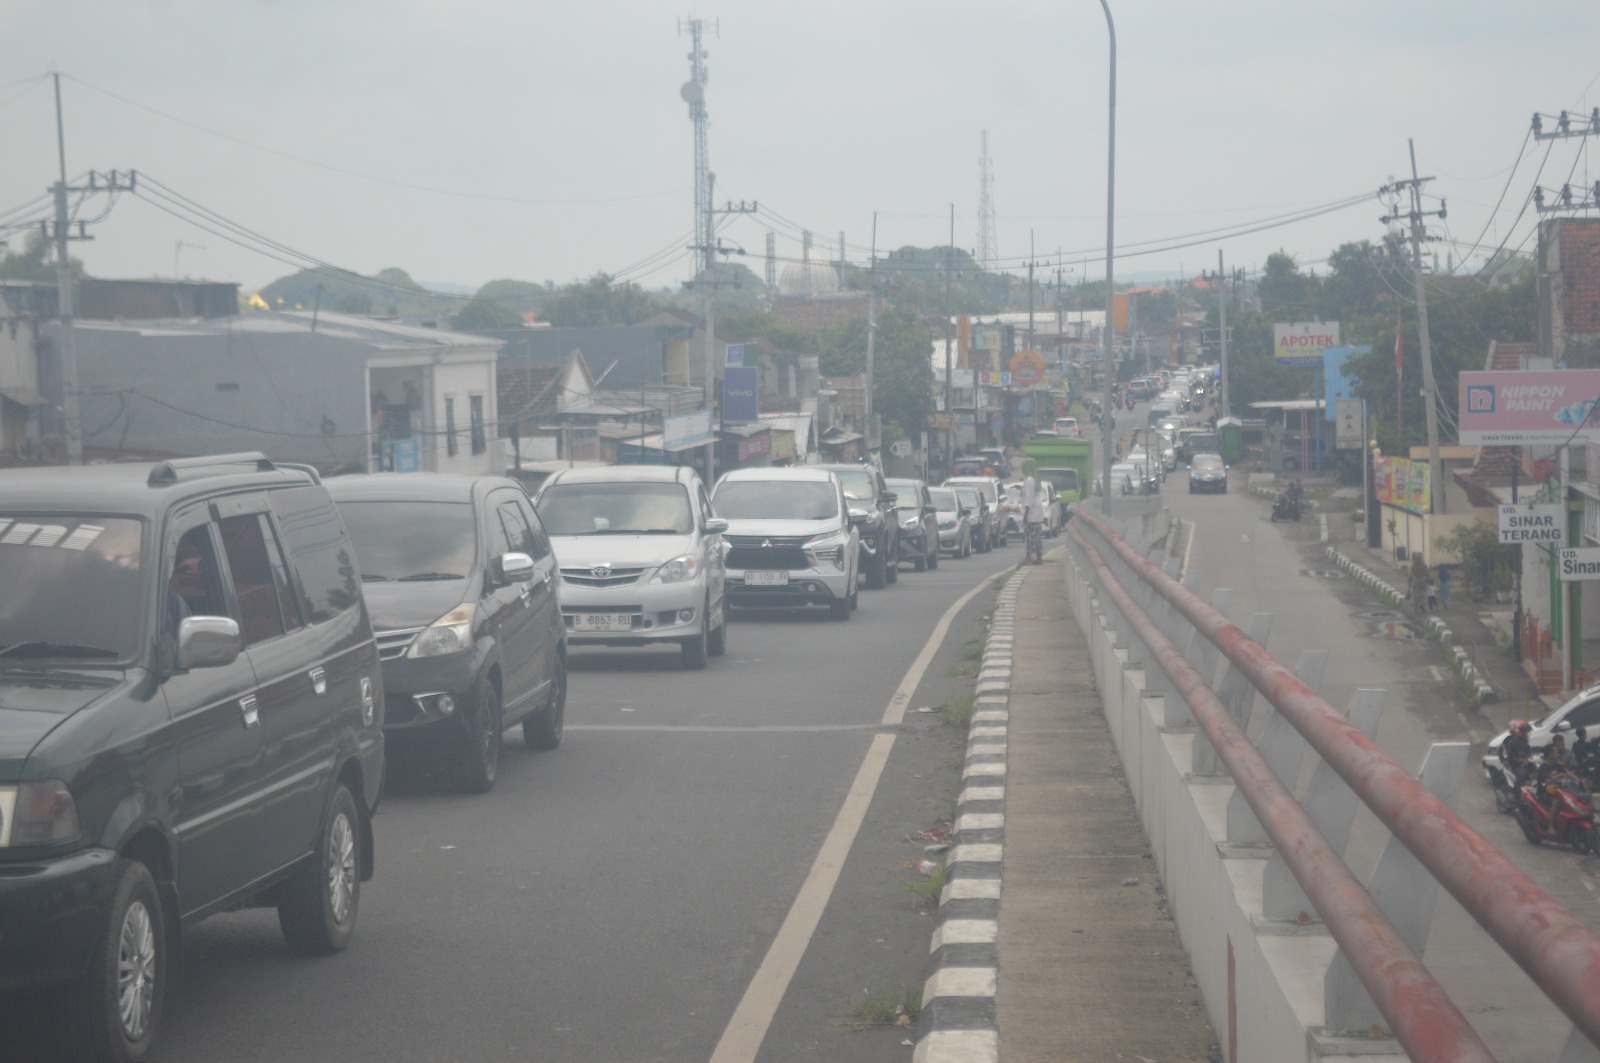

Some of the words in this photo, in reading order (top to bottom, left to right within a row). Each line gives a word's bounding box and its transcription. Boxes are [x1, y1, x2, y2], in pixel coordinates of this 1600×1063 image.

[1280, 334, 1334, 347] APOTEK
[1501, 385, 1565, 399] NIPPON
[1506, 399, 1554, 411] PAINT
[1509, 516, 1553, 527] SINAR
[1502, 529, 1561, 540] TERANG
[1562, 550, 1579, 558] UD.
[575, 615, 581, 625] B
